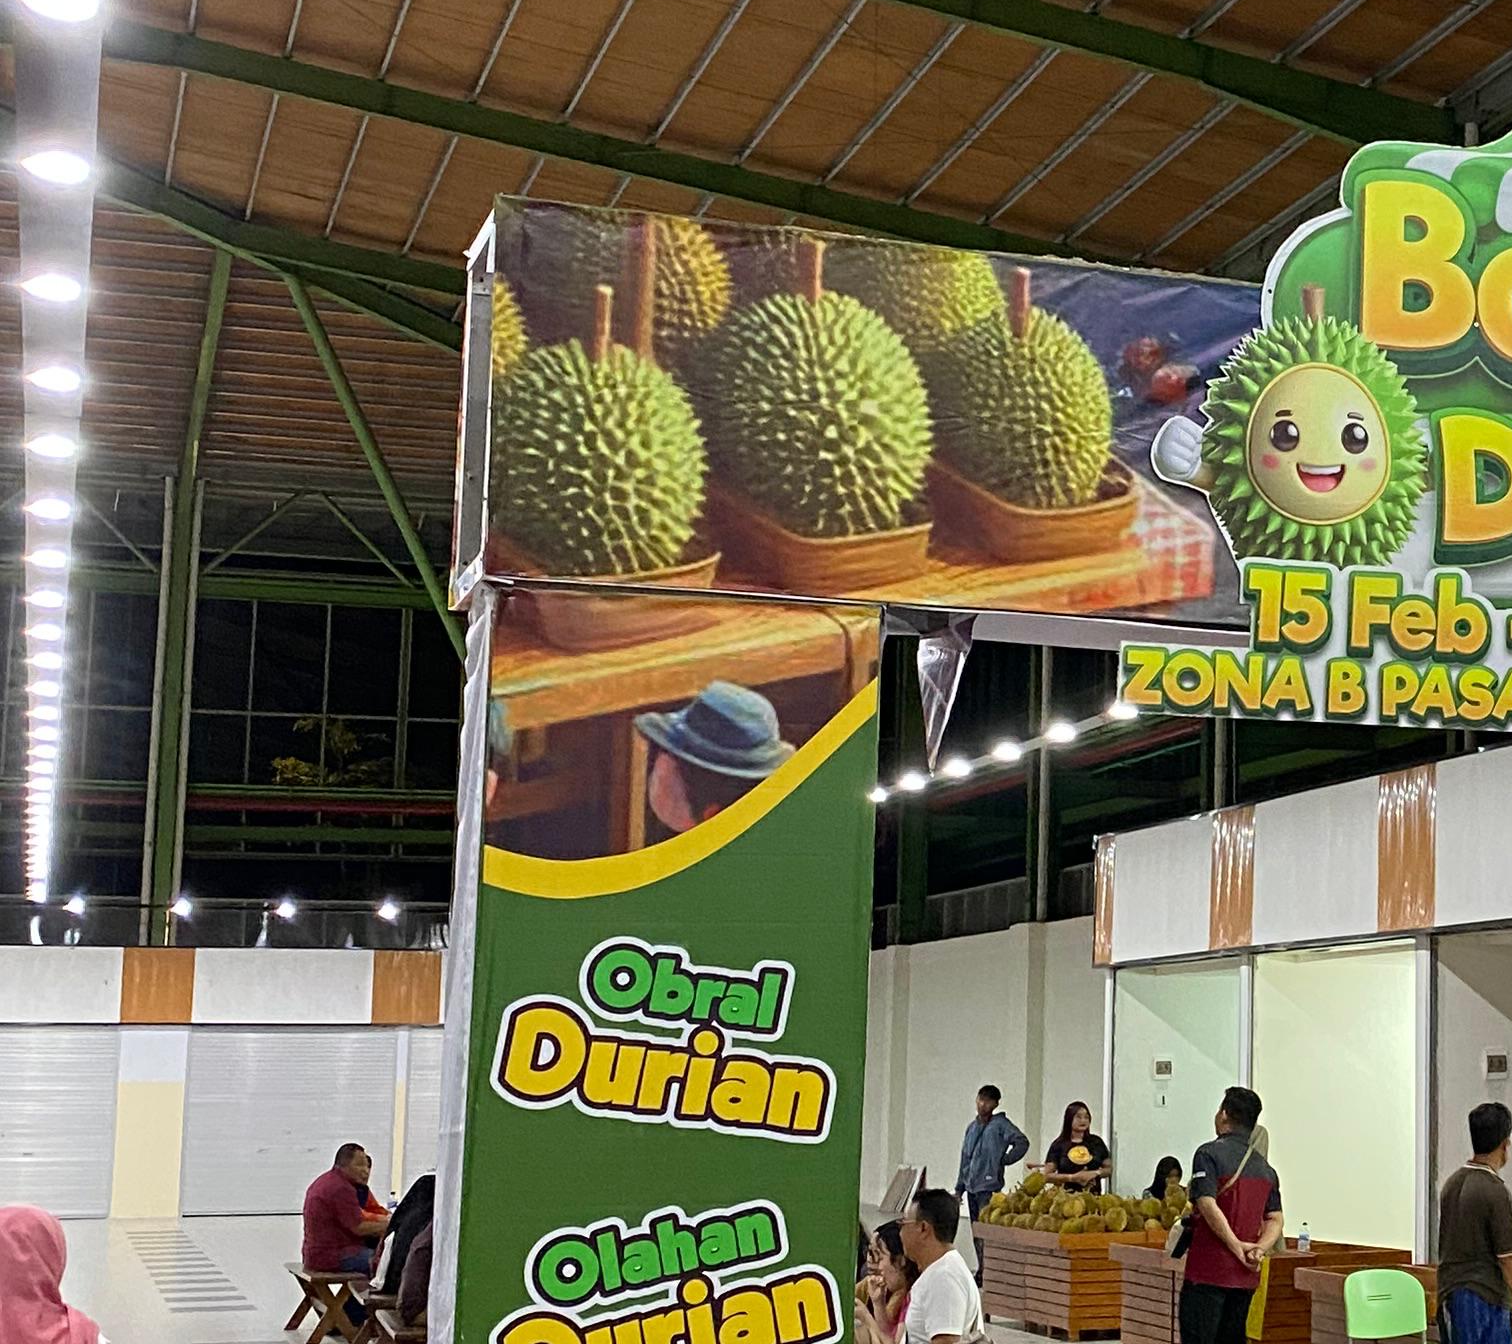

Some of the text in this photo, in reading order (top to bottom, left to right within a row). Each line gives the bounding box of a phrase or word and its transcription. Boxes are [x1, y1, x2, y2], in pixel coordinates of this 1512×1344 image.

[1247, 566, 1333, 650] 15
[1350, 575, 1489, 660] Feb
[1123, 648, 1311, 717] ZONA
[1327, 658, 1366, 717] B
[587, 942, 786, 1035] Obral
[499, 1001, 834, 1137] Durian
[532, 1205, 780, 1308] Olahan
